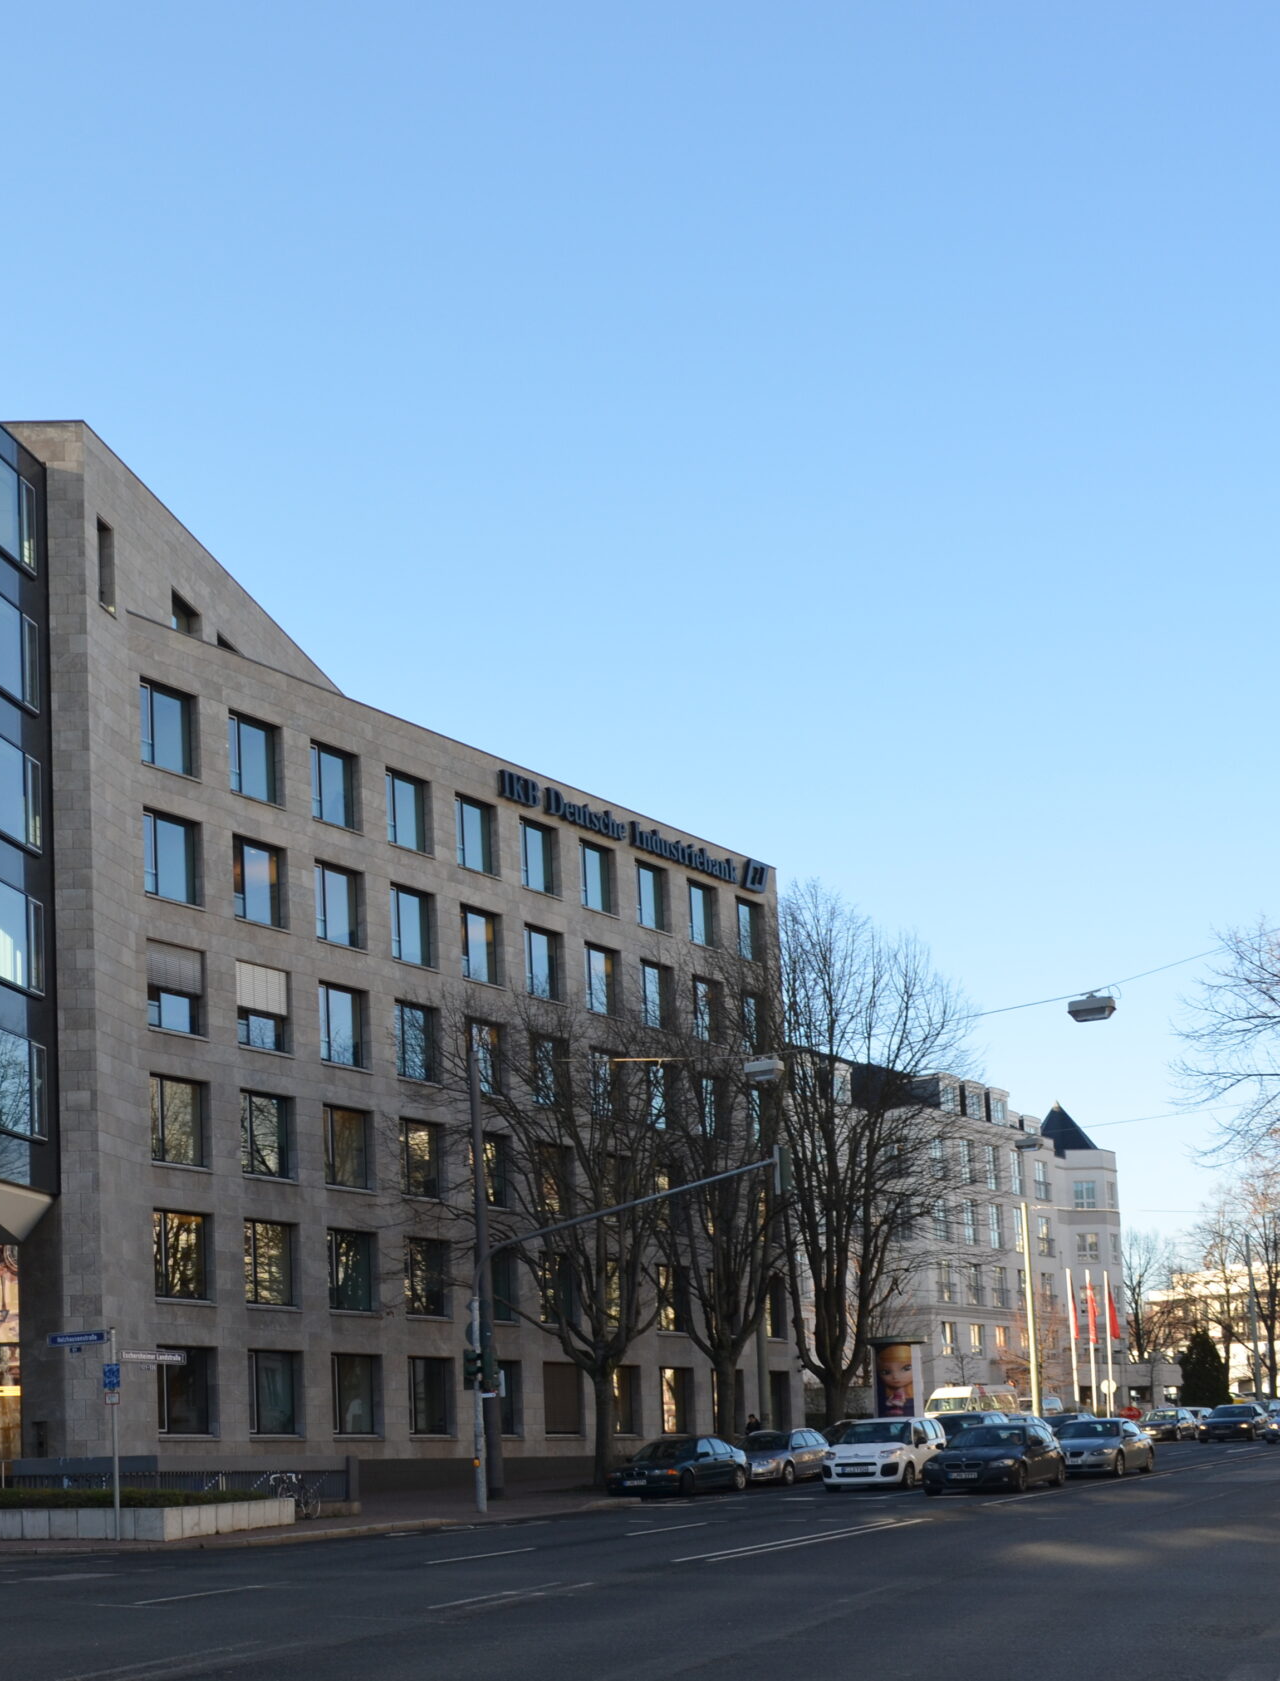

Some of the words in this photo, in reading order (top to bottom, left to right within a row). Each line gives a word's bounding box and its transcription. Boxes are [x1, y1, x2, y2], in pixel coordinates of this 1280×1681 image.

[498, 769, 540, 808] IKB
[544, 786, 627, 841] Deutsche
[629, 820, 738, 885] Industriebank
